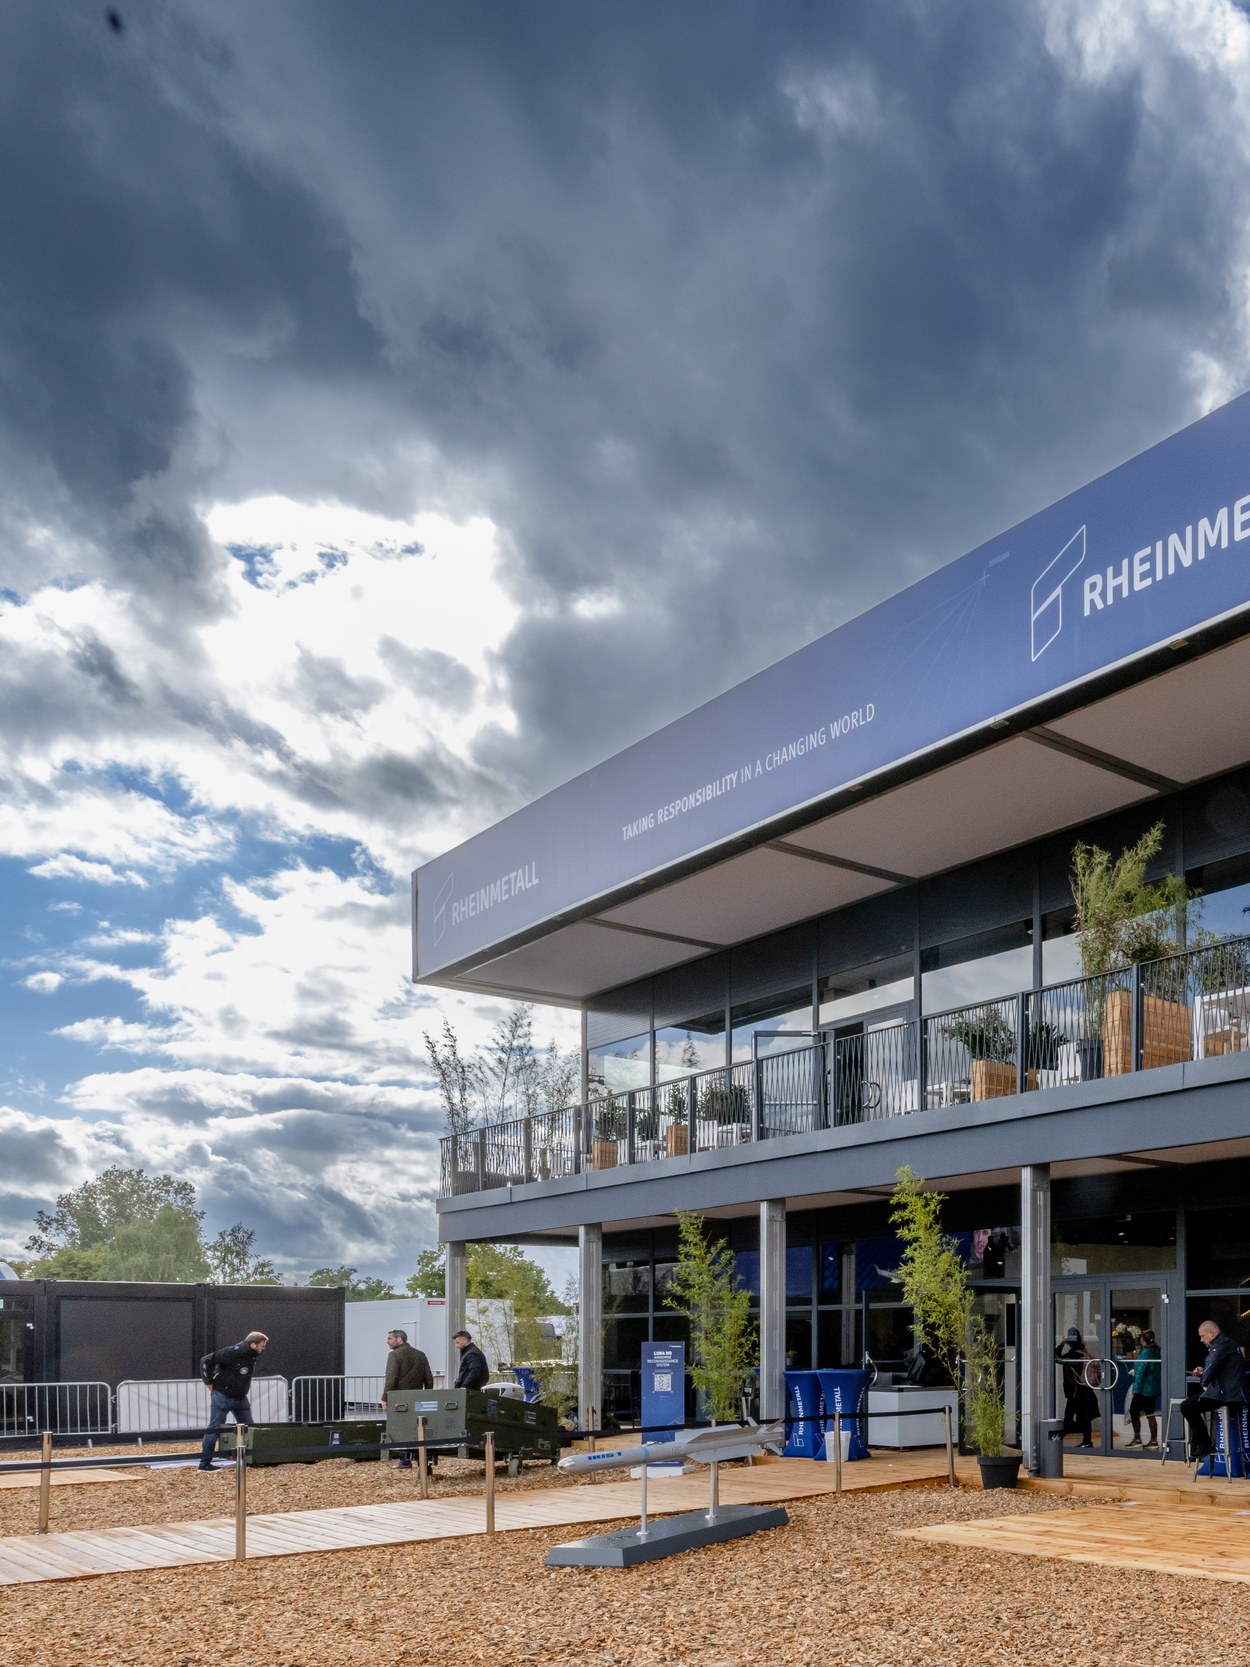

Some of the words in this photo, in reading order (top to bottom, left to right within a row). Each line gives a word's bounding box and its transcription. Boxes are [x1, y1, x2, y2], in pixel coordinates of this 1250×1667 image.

[621, 812, 655, 841] TAKING
[657, 770, 739, 824] RESPONSIBILITY
[740, 766, 752, 784] IN
[754, 759, 763, 777] A
[765, 727, 826, 771] CHANGING
[829, 703, 875, 740] WORLD
[452, 861, 540, 927] RHEINMETALL
